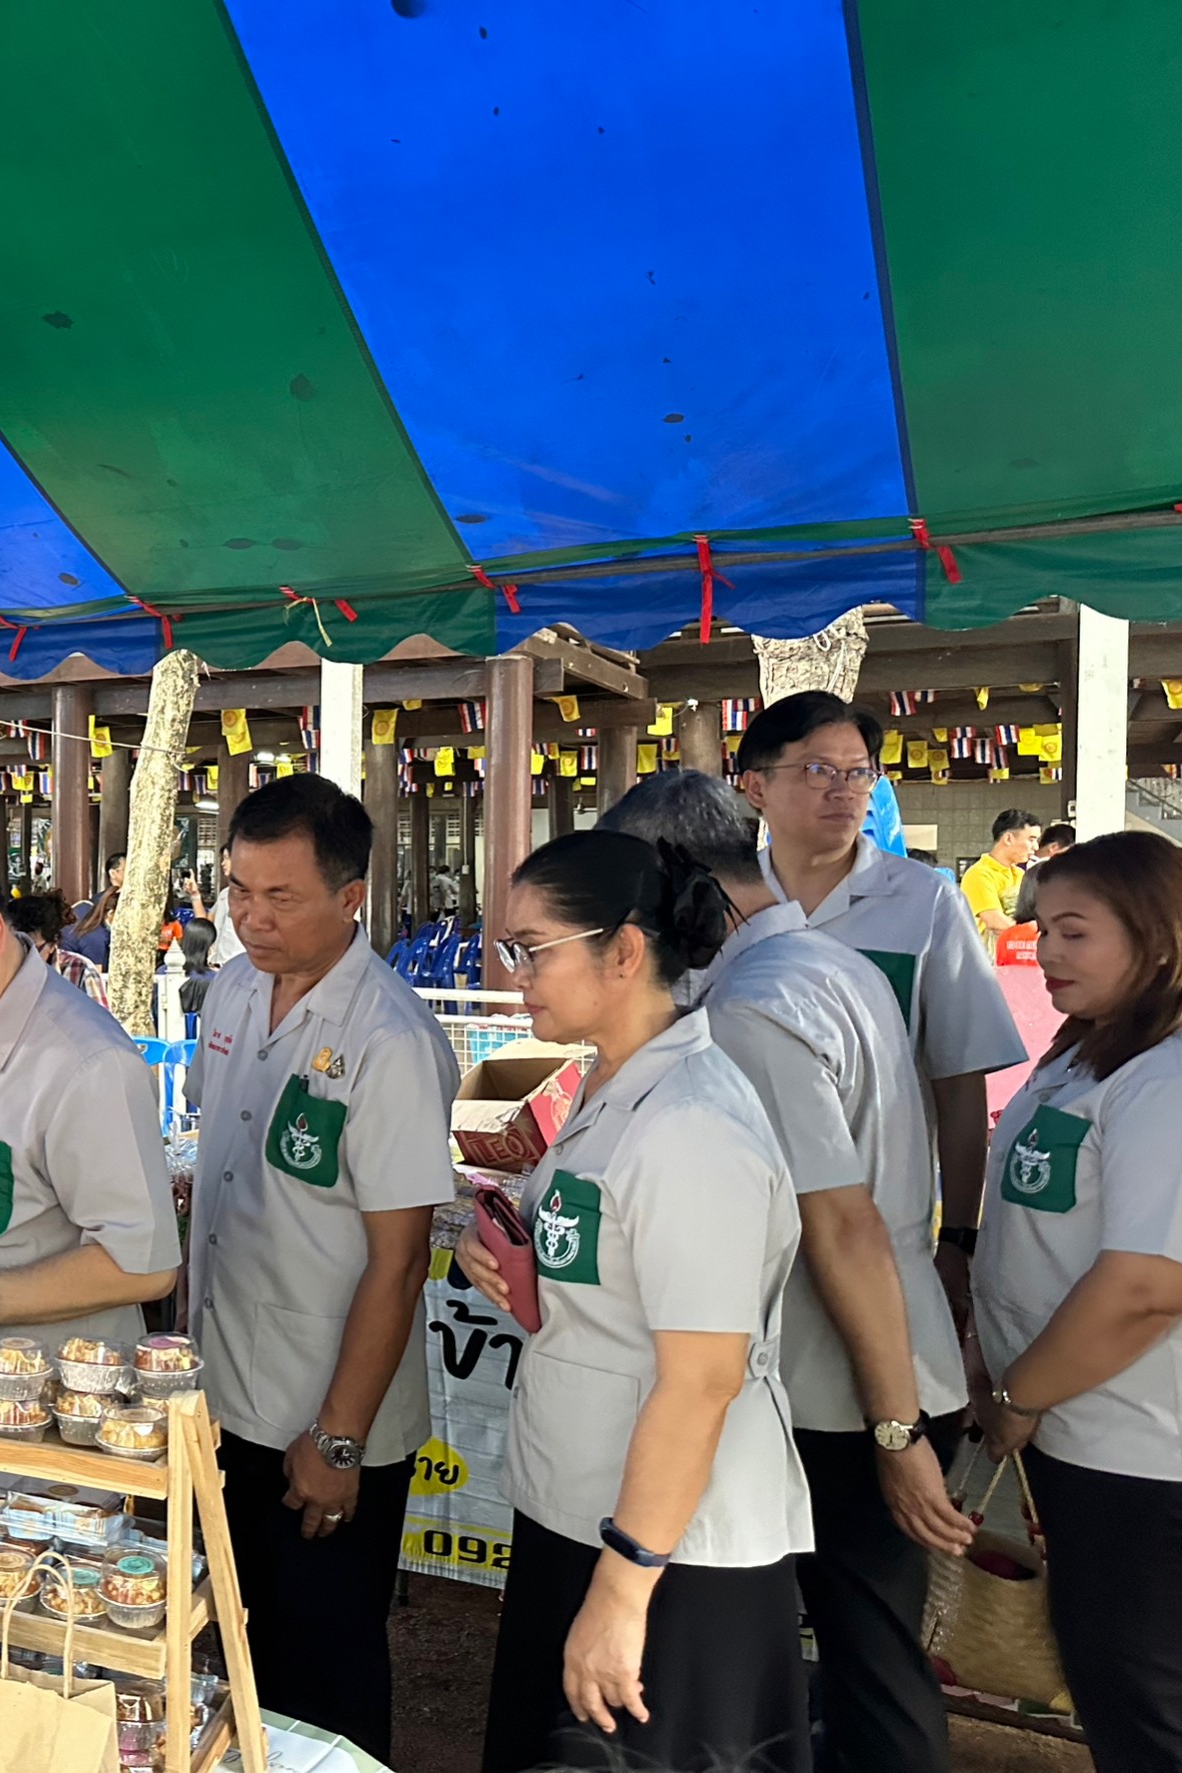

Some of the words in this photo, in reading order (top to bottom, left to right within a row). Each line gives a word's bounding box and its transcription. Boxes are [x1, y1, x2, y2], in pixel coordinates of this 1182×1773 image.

[470, 1132, 529, 1164] LEO
[411, 1456, 460, 1485] าย
[424, 1529, 512, 1569] 092
